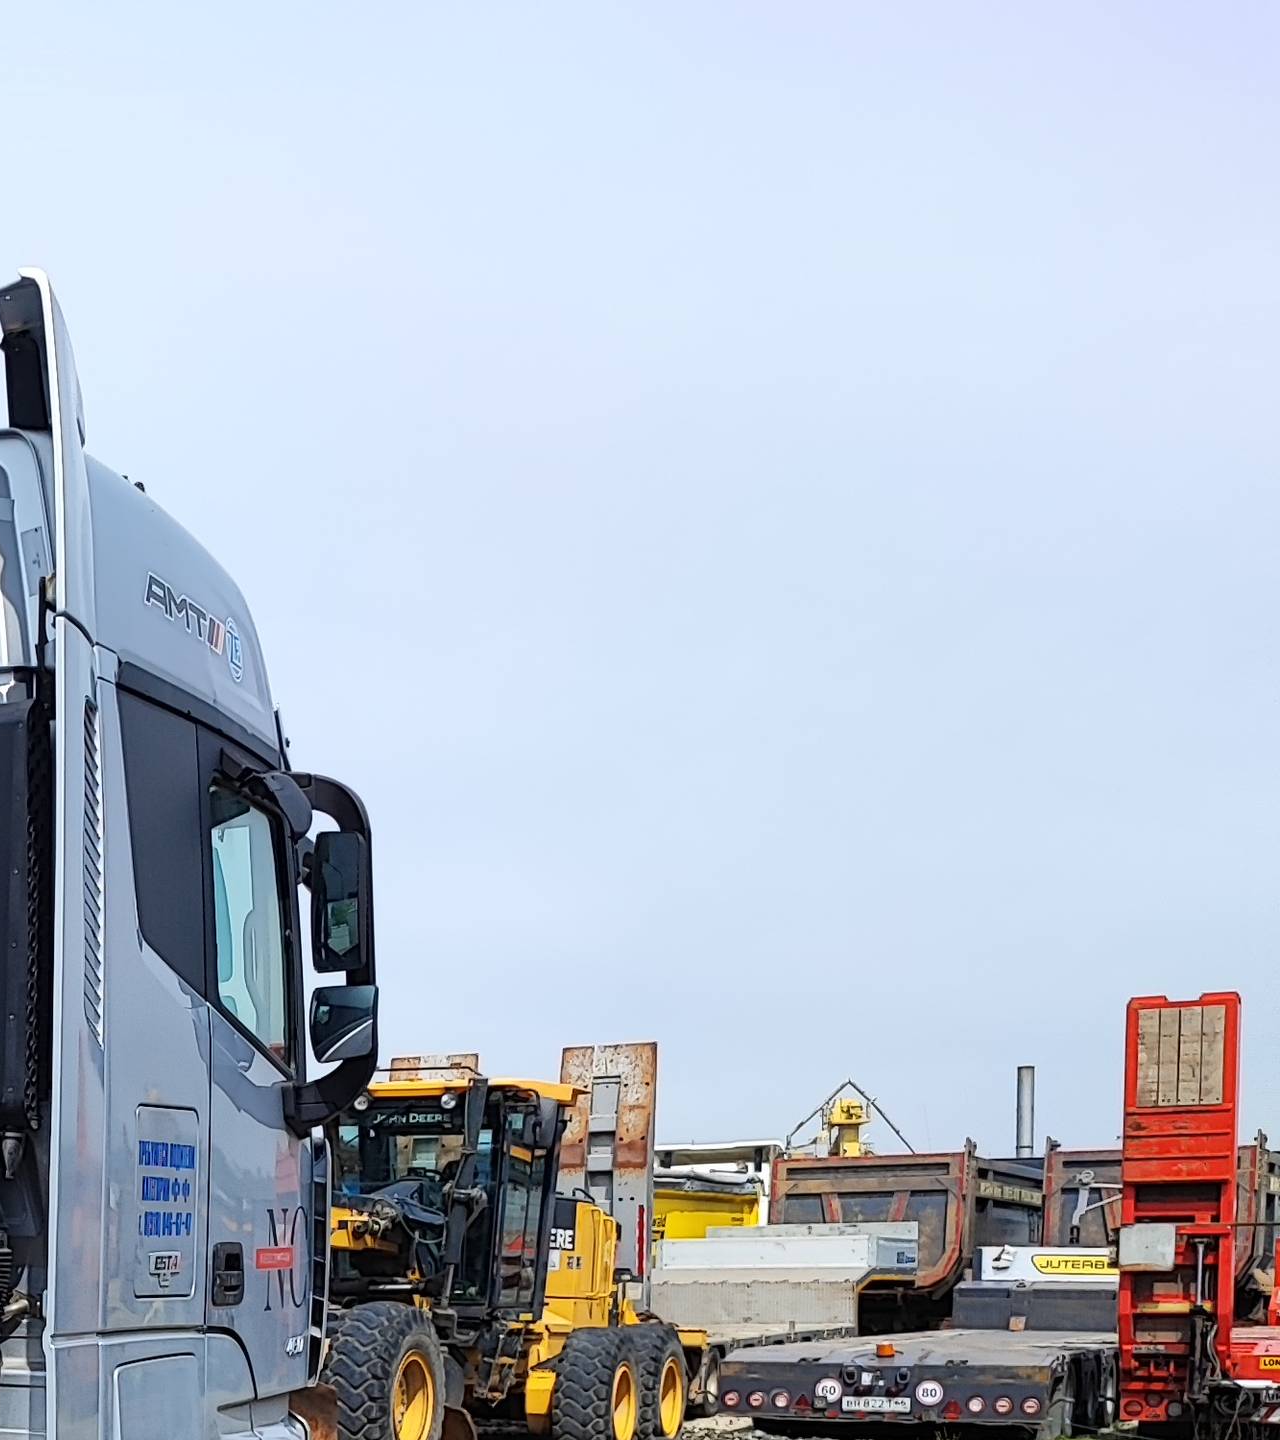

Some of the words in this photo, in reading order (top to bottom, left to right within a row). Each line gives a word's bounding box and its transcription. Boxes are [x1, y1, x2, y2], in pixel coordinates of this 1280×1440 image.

[145, 573, 208, 640] AMT
[549, 1228, 574, 1250] ERE
[821, 1385, 836, 1396] 60
[921, 1387, 937, 1398] 80
